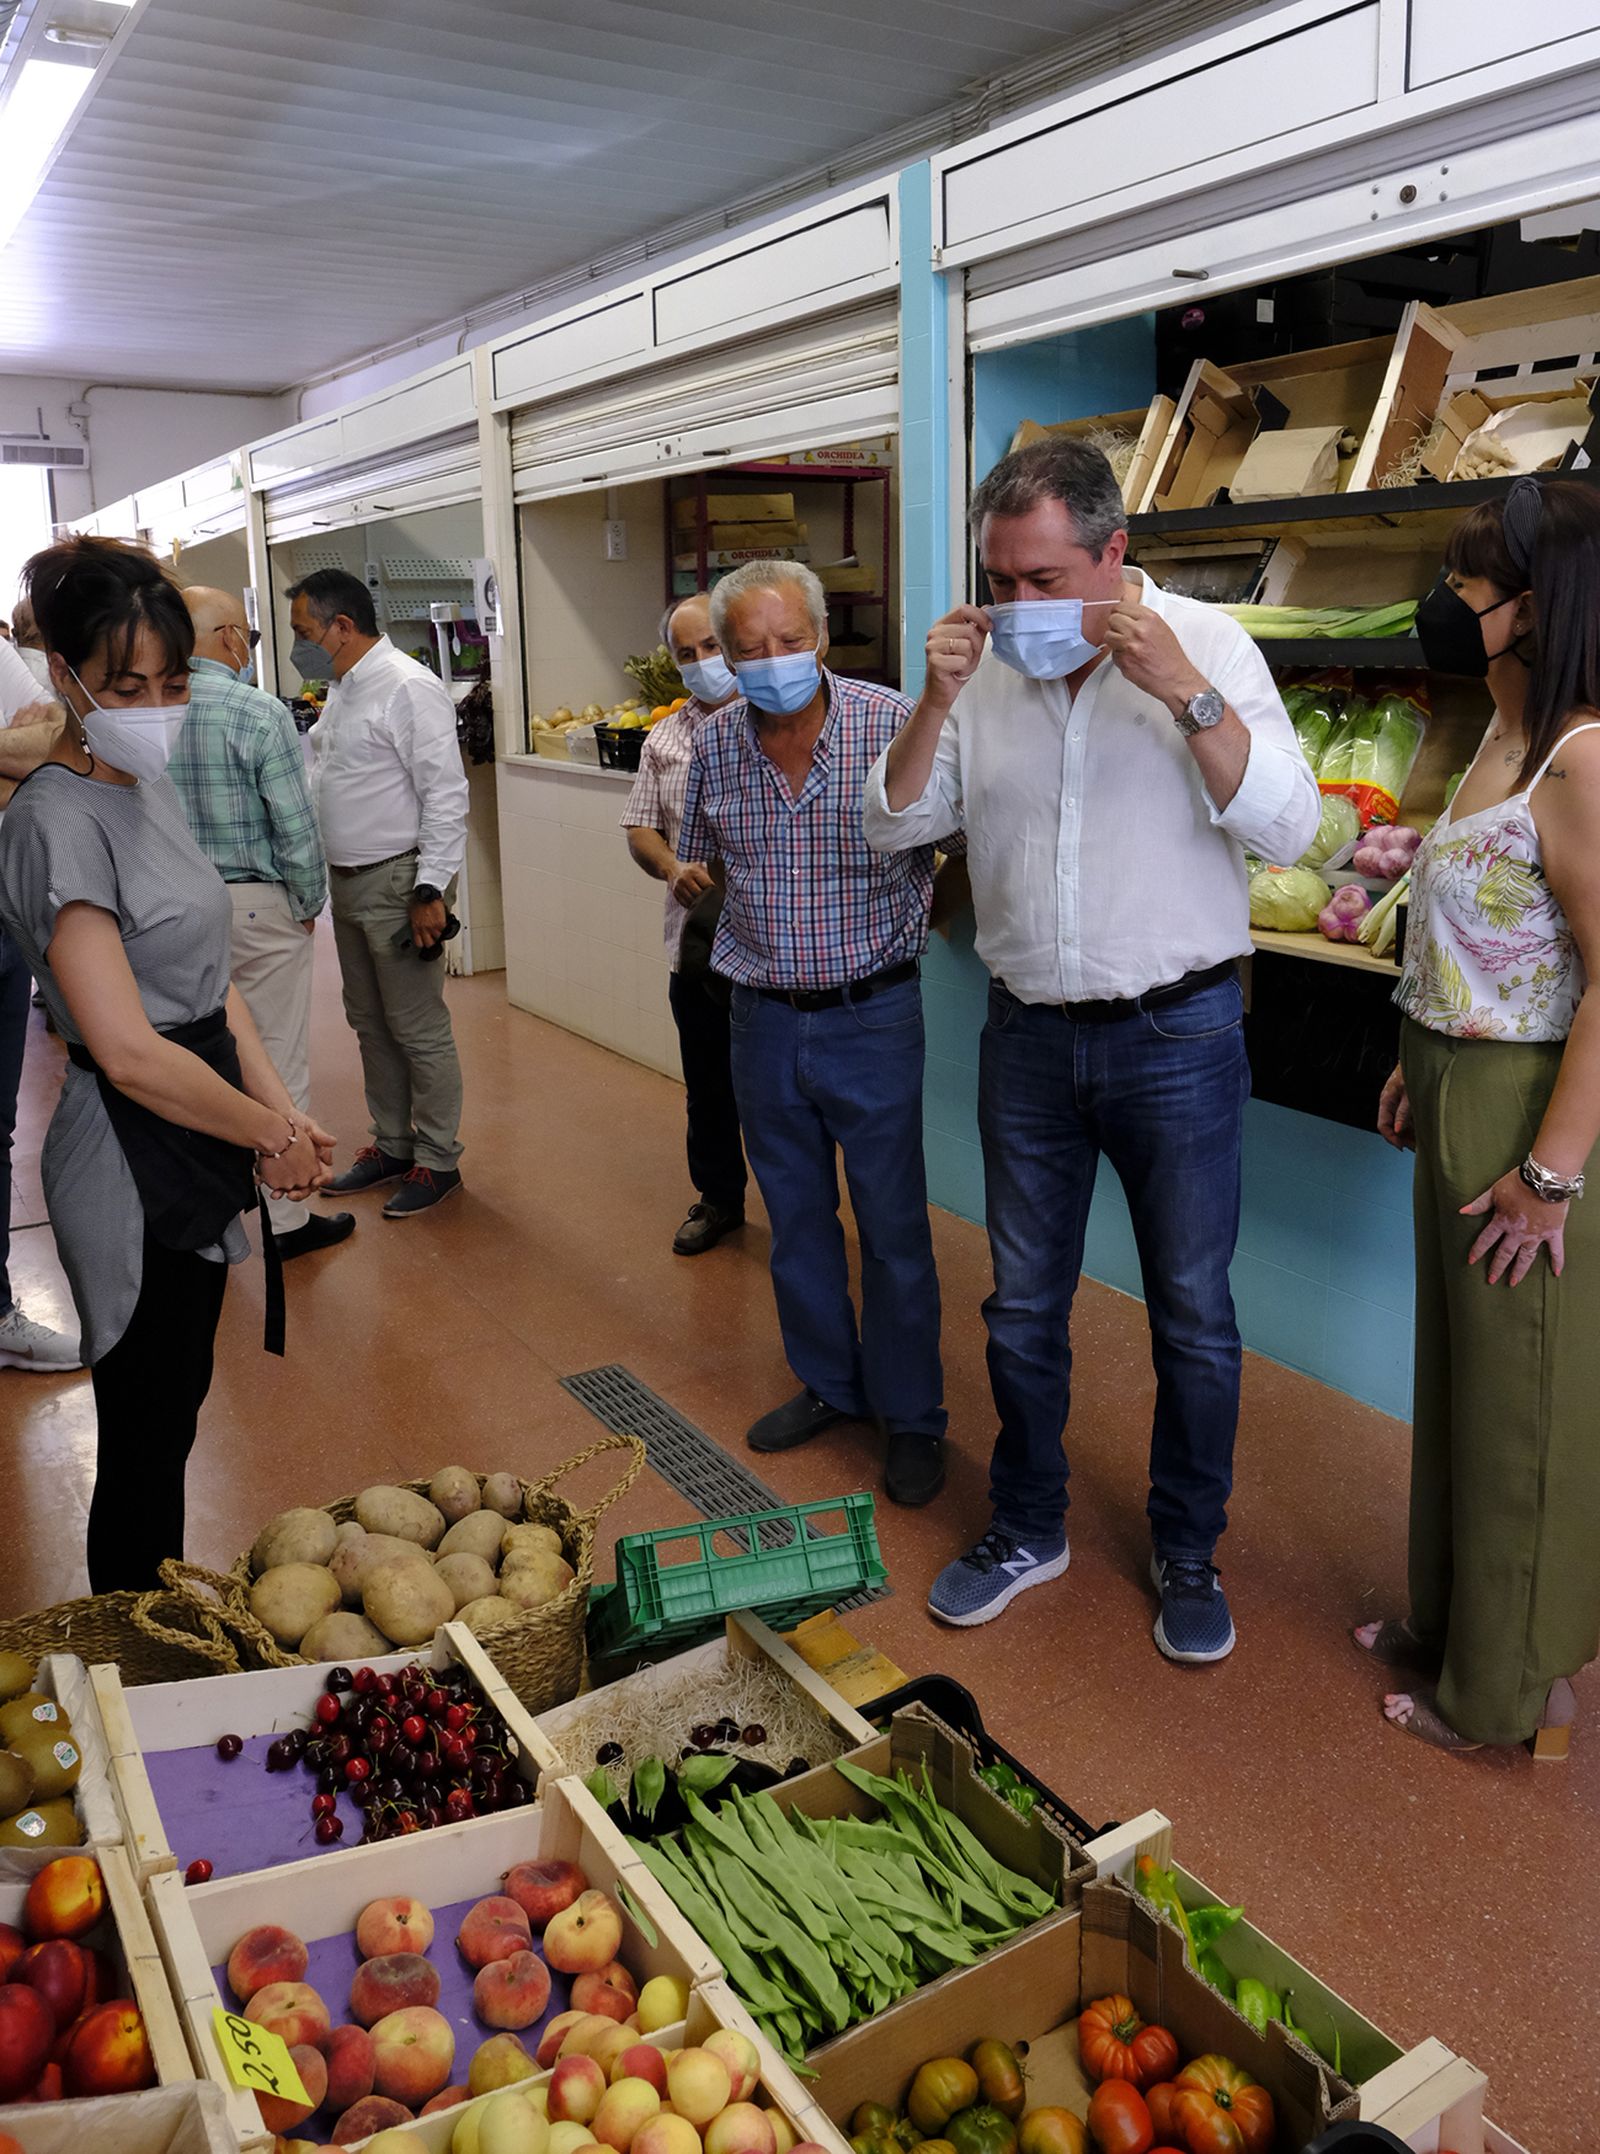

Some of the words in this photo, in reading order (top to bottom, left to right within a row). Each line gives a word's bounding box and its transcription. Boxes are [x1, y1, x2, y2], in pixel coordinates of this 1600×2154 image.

[817, 450, 865, 460] ORCHIDEA
[730, 549, 781, 560] ORCHIDEA
[1000, 1547, 1039, 1577] N
